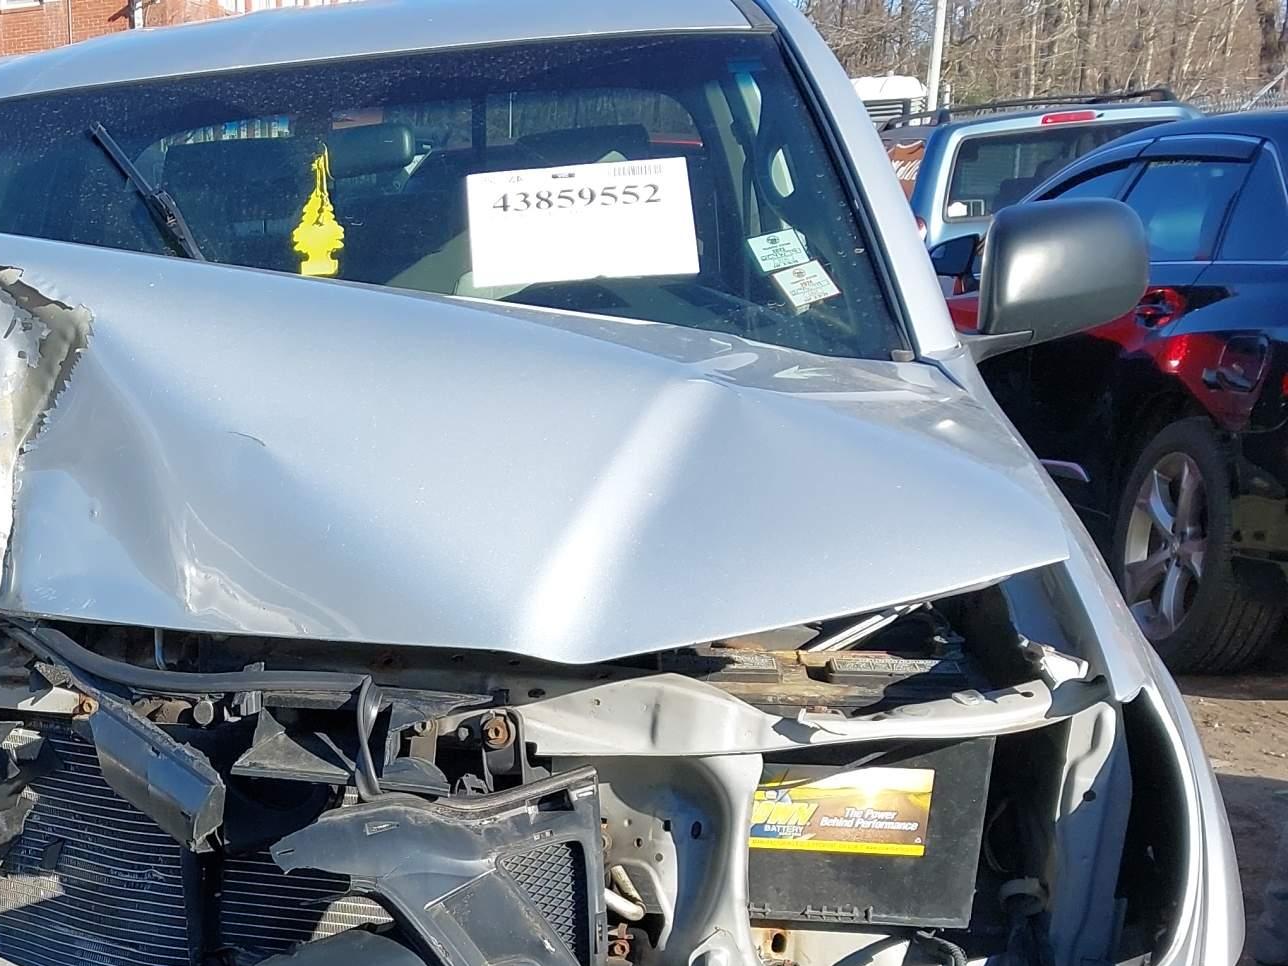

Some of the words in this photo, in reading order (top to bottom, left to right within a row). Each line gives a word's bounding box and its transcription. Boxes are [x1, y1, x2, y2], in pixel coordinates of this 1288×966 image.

[493, 184, 662, 212] 43859552
[844, 807, 864, 818] The
[864, 808, 898, 820] Power
[763, 824, 804, 833] BATTERY
[820, 816, 855, 828] Behind
[854, 818, 919, 831] Performance
